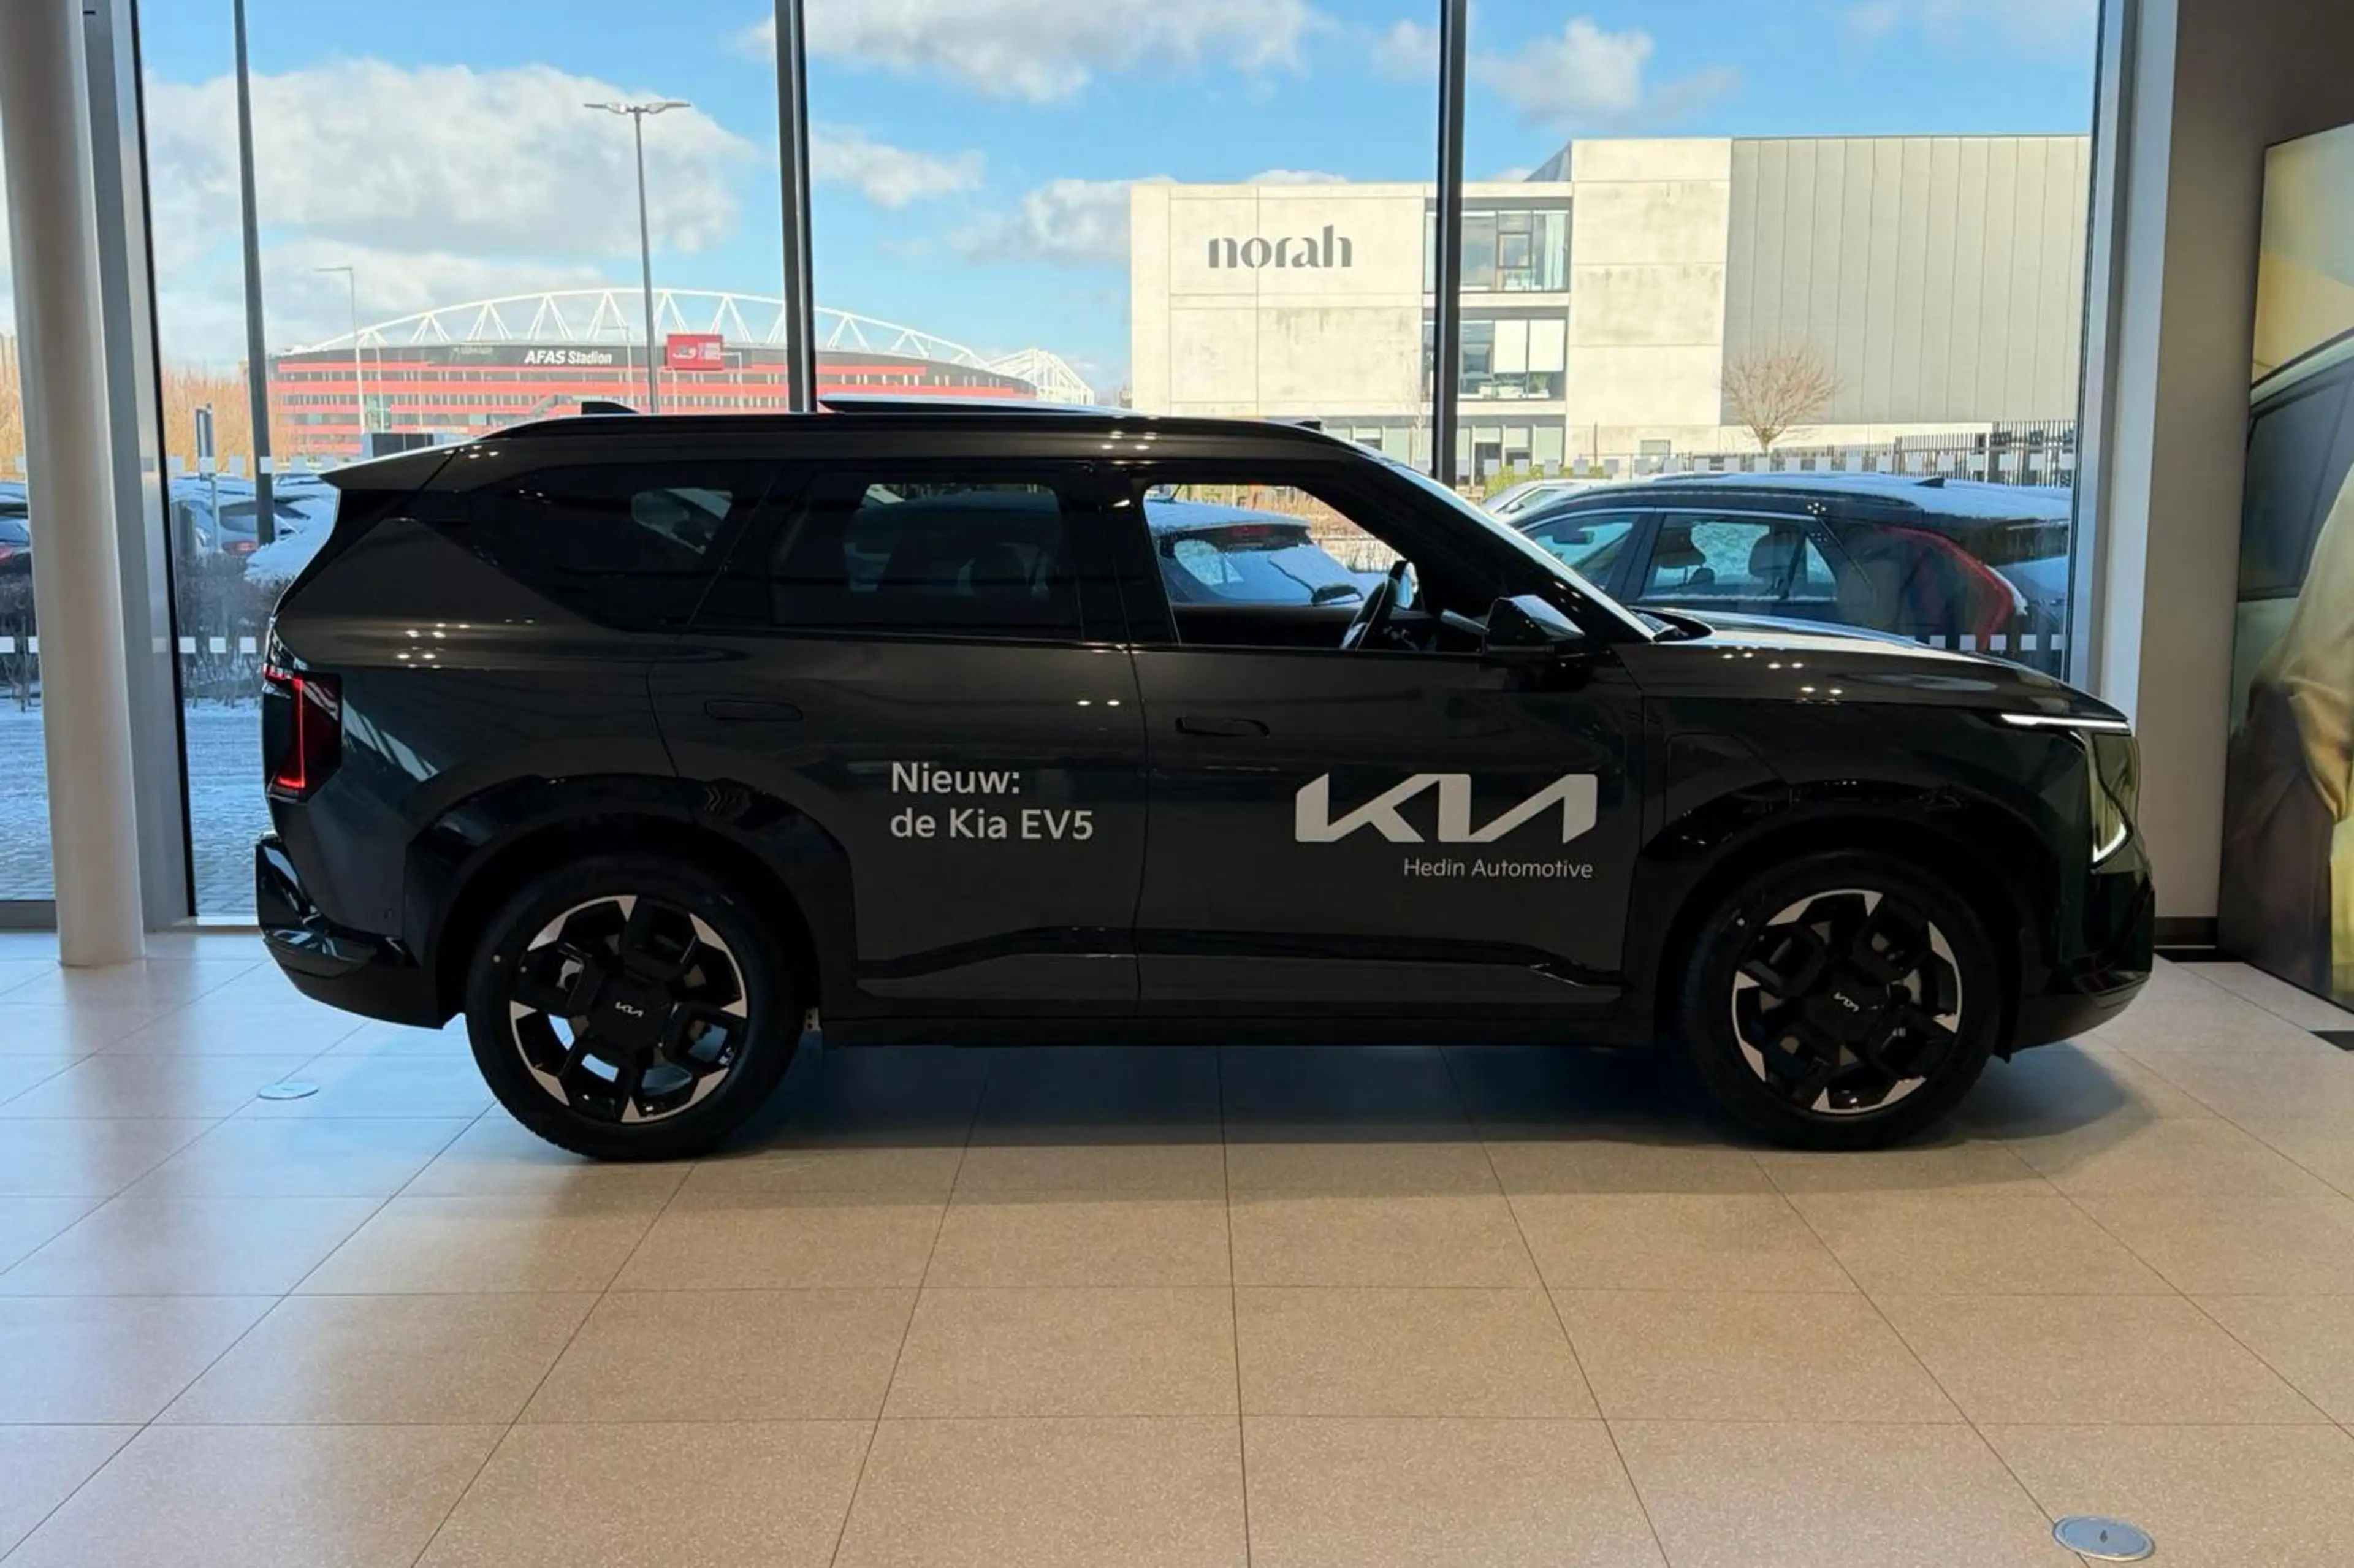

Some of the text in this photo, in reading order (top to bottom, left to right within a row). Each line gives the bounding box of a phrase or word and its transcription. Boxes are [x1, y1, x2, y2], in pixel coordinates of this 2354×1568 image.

[1209, 224, 1352, 268] norah
[524, 349, 612, 365] AFAS Stadion
[891, 762, 1019, 794] Nieuw:
[890, 808, 1093, 840] de Kia EV5
[1295, 773, 1598, 844] KIA
[1404, 859, 1593, 878] Hedin Automotive
